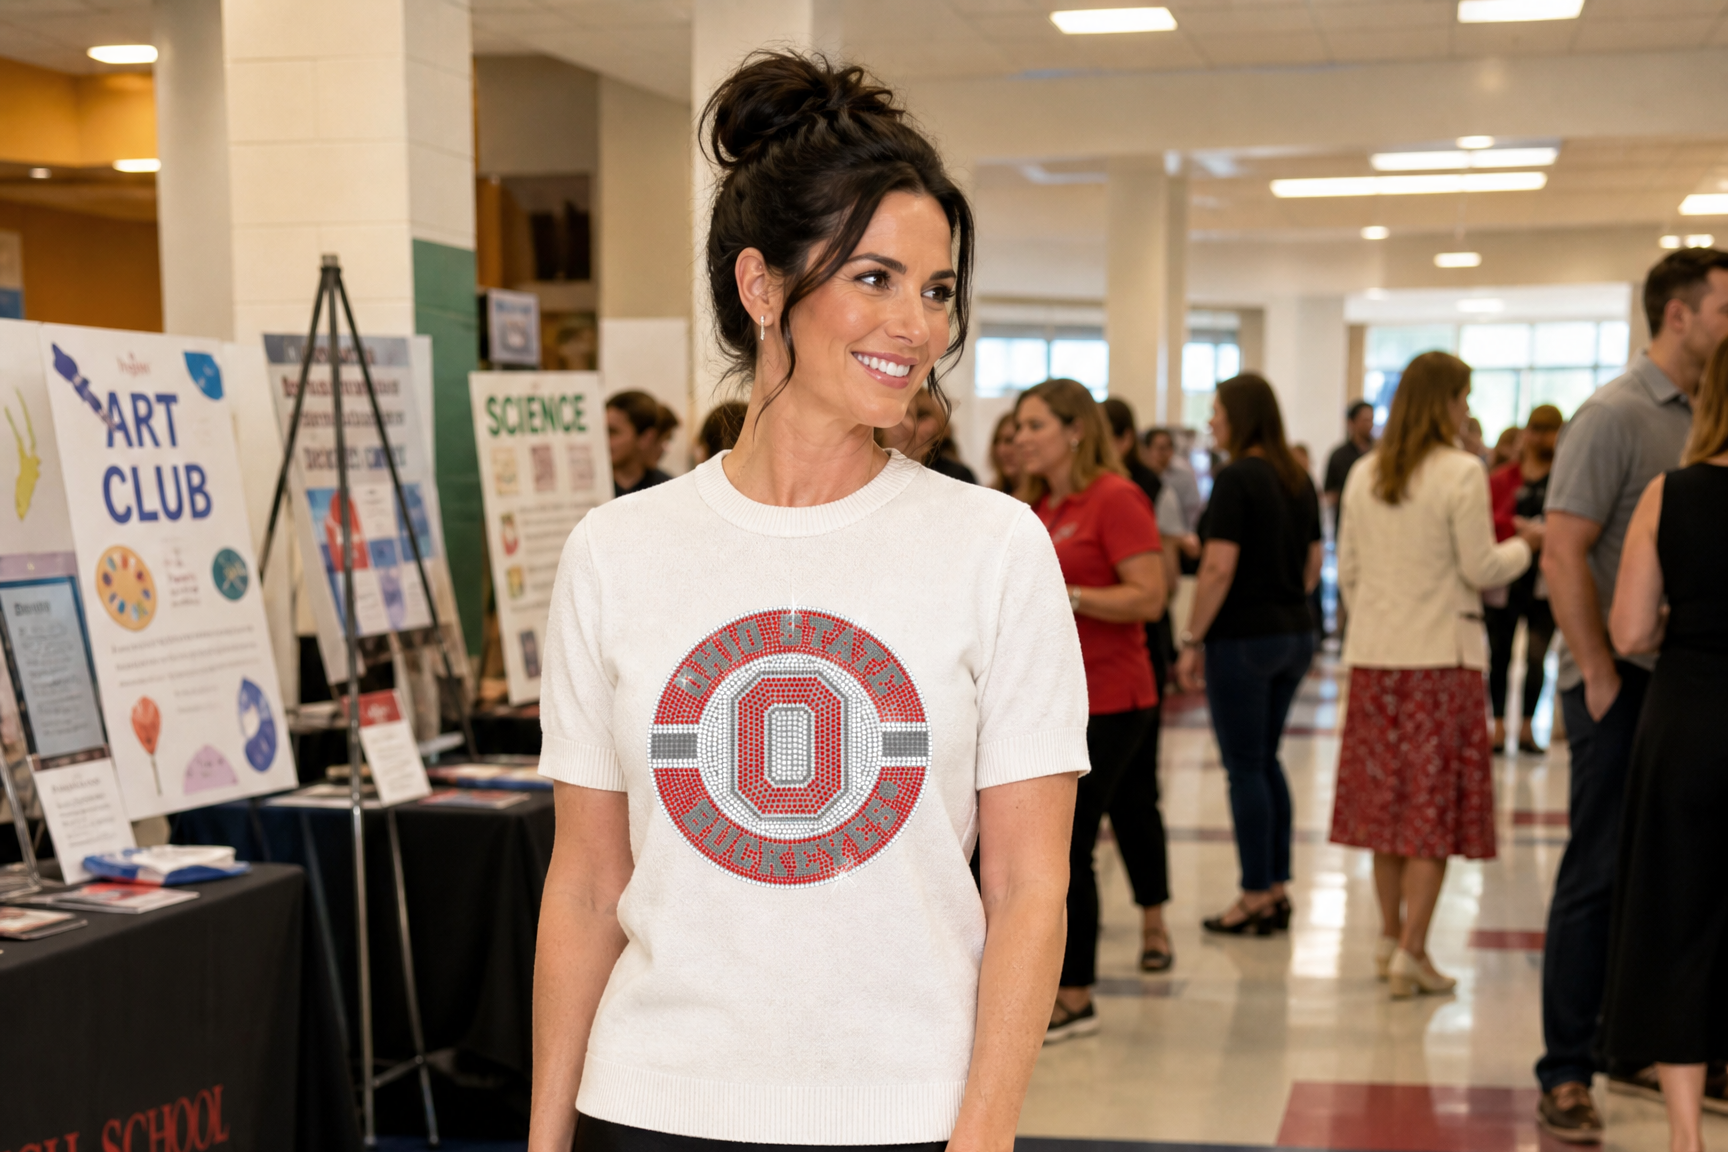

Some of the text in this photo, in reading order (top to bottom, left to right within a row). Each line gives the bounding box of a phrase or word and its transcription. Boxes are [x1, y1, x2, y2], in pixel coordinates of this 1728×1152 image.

[107, 391, 178, 448] ART
[485, 395, 587, 437] SCIENCE
[103, 464, 213, 524] CLUB
[674, 614, 905, 698] OHIO STATE
[731, 671, 848, 821] O
[681, 797, 899, 877] BUCKEYES
